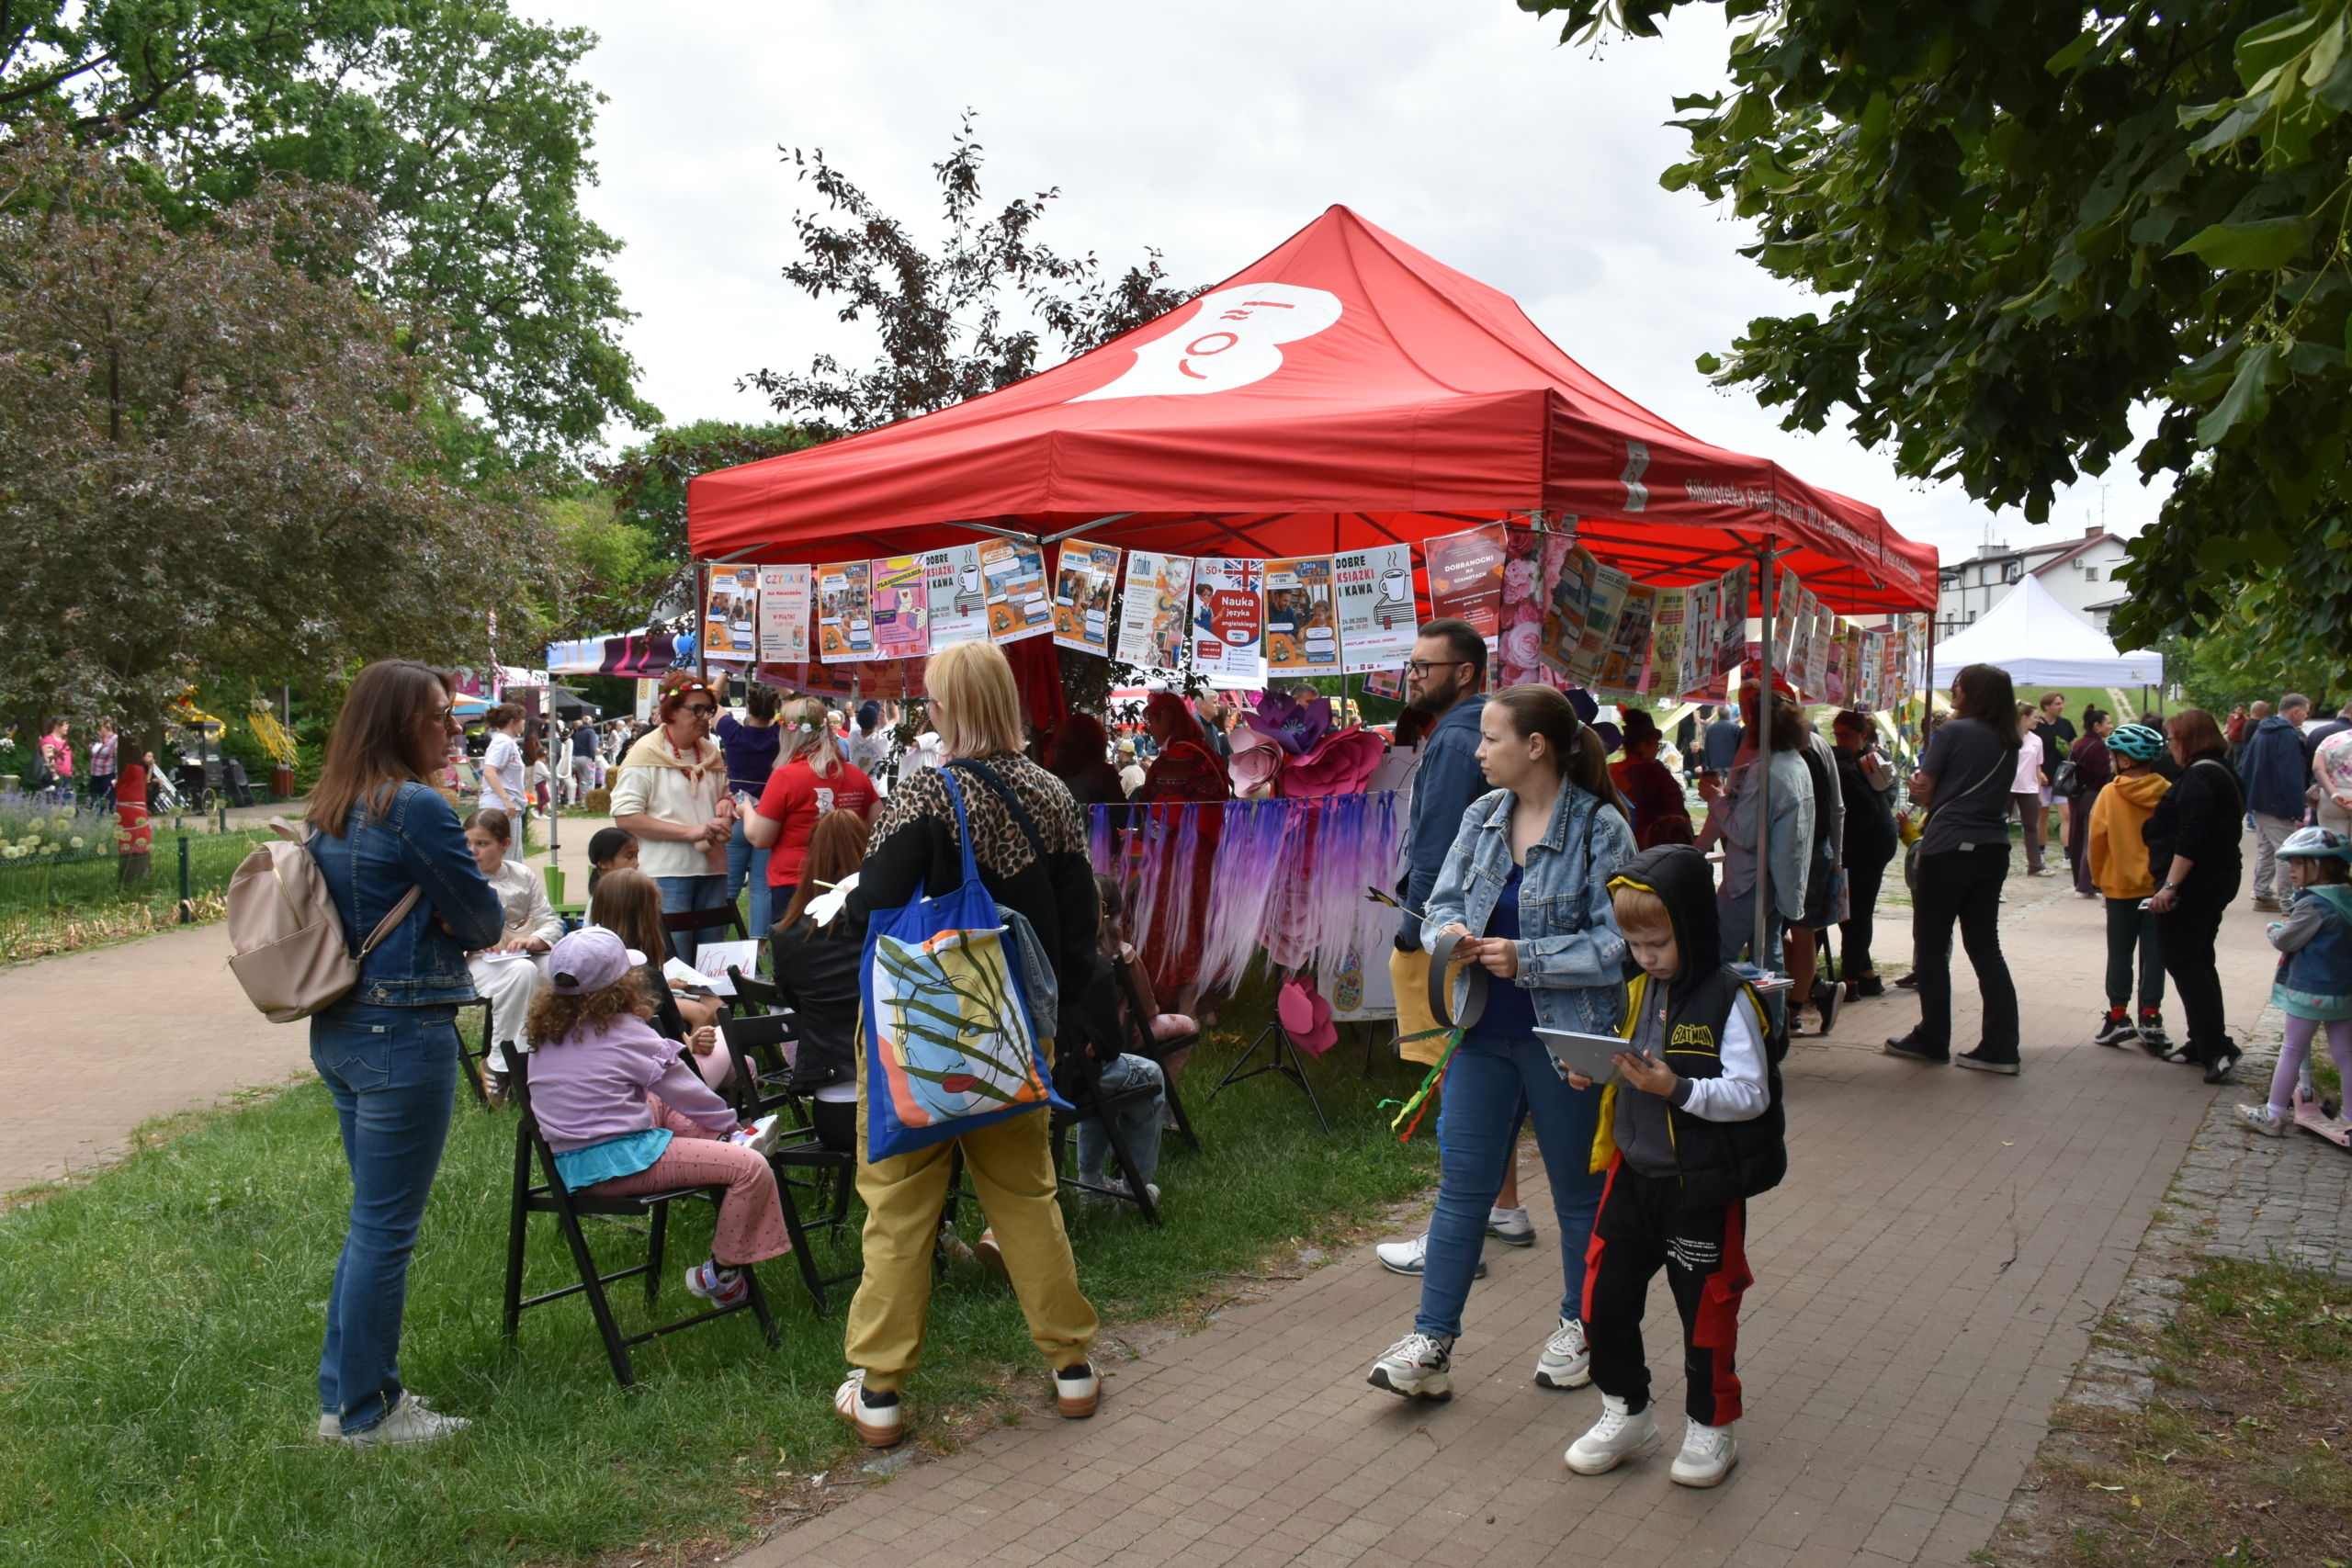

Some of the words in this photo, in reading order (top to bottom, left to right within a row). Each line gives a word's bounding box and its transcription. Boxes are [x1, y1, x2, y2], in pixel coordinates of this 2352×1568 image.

[1685, 479, 1746, 507] Biblioteka
[1747, 487, 1792, 519] Publiczna
[926, 553, 949, 566] DOBRE
[1132, 553, 1151, 576] Sztuka
[1336, 555, 1366, 570] DOBRE
[1444, 555, 1494, 572] DOBRANOCKI
[927, 563, 955, 578] KSIĄŻKI
[1098, 564, 1114, 573] 2026
[1205, 566, 1223, 575] 50+
[1300, 567, 1328, 577] Czyta
[765, 573, 808, 584] CZYTANKI
[876, 569, 922, 589] PLANSZOMANIA
[1337, 567, 1374, 584] KSIĄŻKI
[1453, 571, 1487, 584] SZAMOTACH
[1599, 571, 1614, 582] PRZEZ
[933, 577, 954, 589] KAWA
[1338, 587, 1341, 597] I
[1344, 583, 1373, 597] KAWA
[1221, 596, 1254, 607] Nauka
[1226, 608, 1250, 618] języka
[1221, 620, 1257, 628] angielskiego
[1341, 616, 1368, 626] 24.06.2026
[1672, 1024, 1713, 1047] BATMAN
